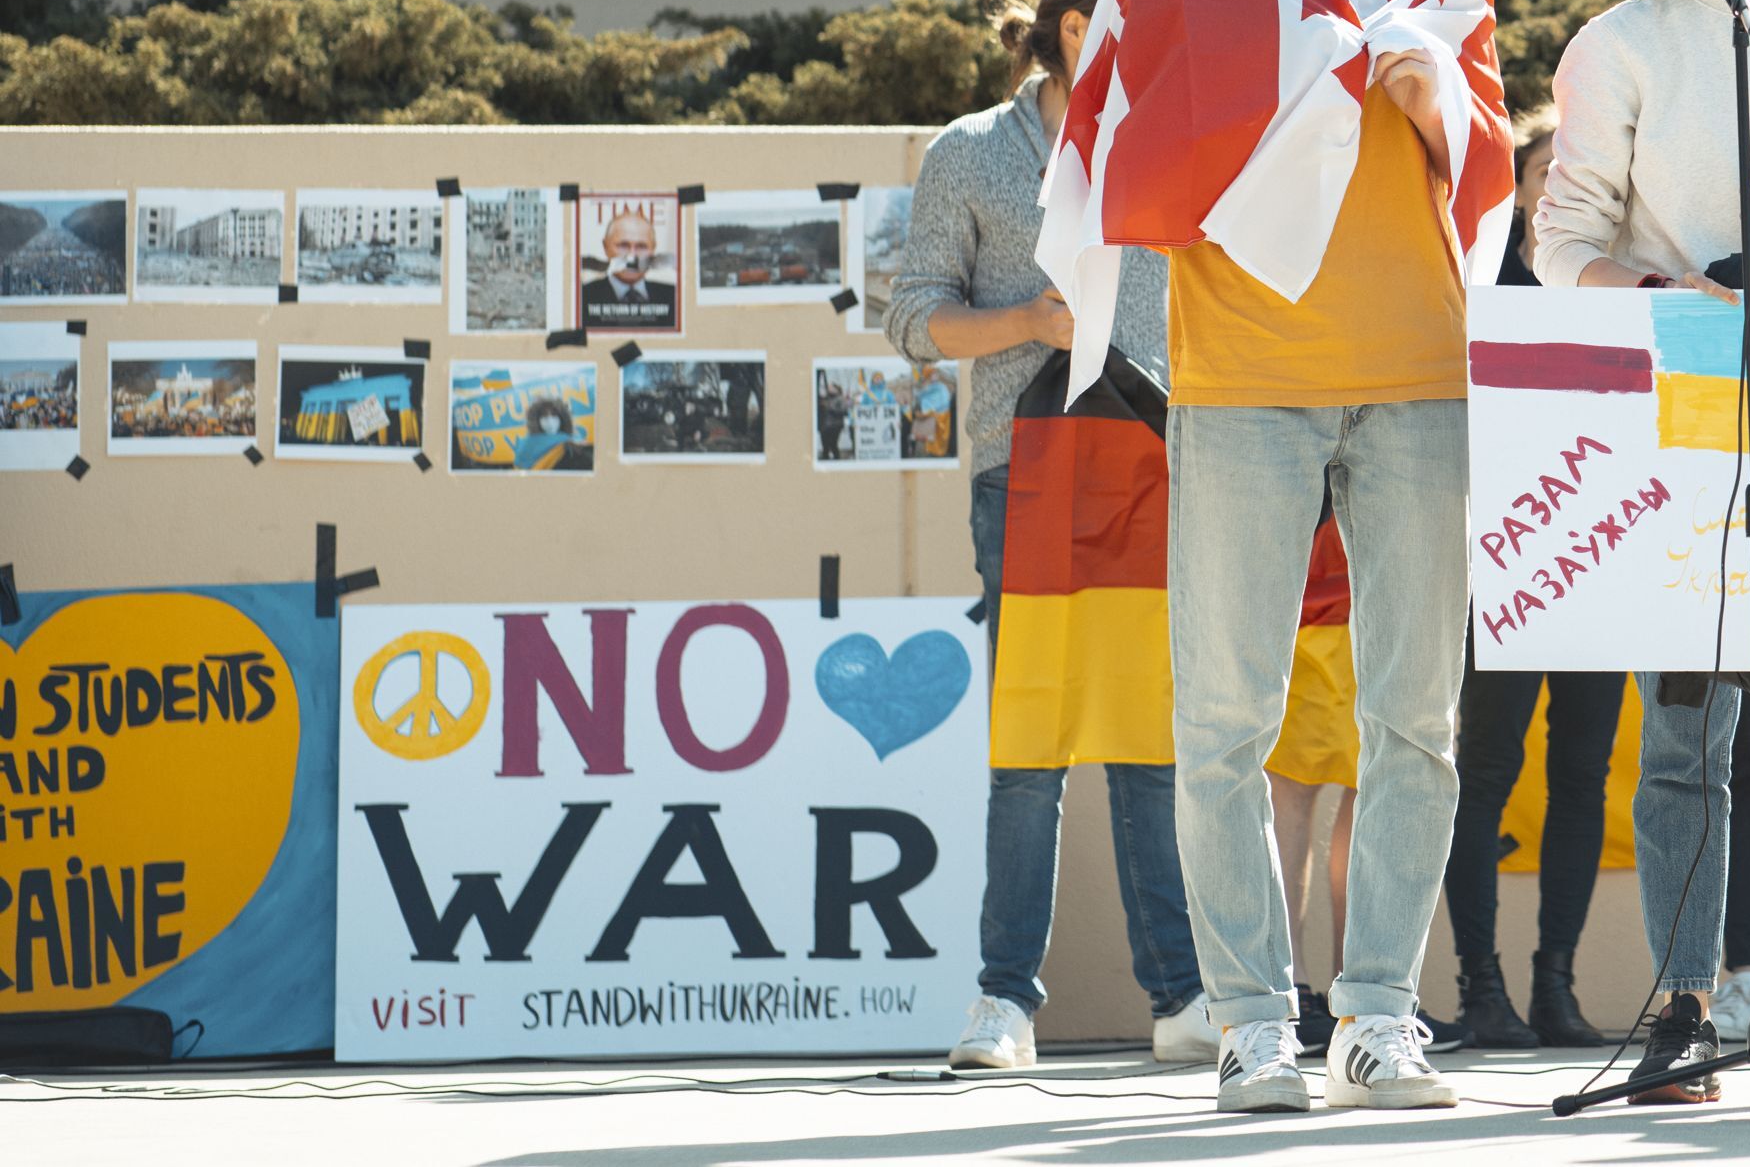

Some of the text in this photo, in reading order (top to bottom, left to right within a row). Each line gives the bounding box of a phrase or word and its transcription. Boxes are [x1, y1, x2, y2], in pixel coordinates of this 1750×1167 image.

[1479, 435, 1613, 570] РАЗАМ
[32, 651, 276, 736] STUDENTS
[494, 602, 790, 777] NO
[353, 801, 939, 963] WAR
